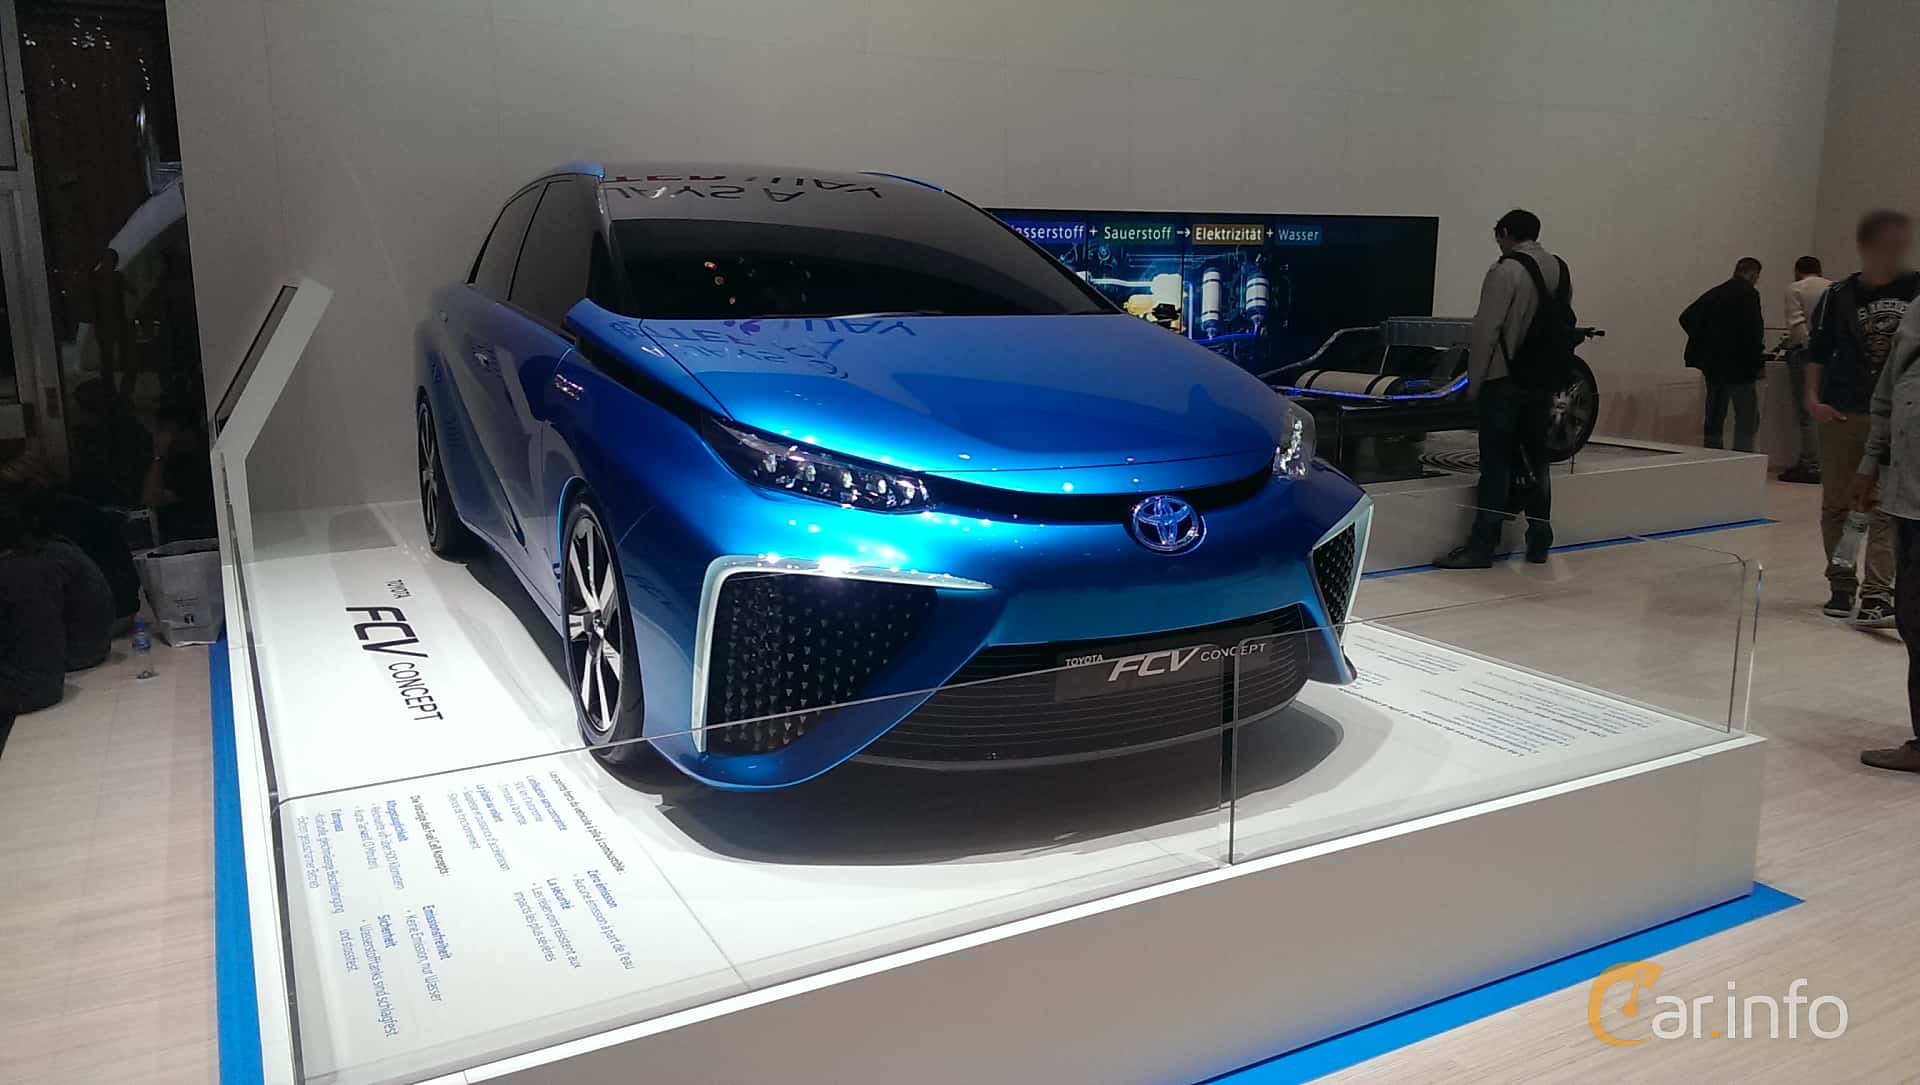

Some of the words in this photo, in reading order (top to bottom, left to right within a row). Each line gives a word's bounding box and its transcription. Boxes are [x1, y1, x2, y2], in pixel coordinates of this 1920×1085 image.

[1012, 225, 1085, 241] asserstoff
[1103, 225, 1172, 240] Sauerstoff
[1195, 227, 1262, 241] Elektrizität
[1277, 228, 1319, 241] Wasser
[345, 606, 429, 658] FCV
[388, 662, 444, 721] CONCEPT
[1065, 653, 1104, 668] TOYOTA
[1107, 645, 1202, 682] FCV
[1200, 642, 1267, 663] CONCEPT
[376, 913, 398, 948] Sicherheit
[404, 913, 422, 933] Keine
[419, 961, 434, 976] nur
[372, 978, 390, 997] sind
[422, 973, 446, 1003] Wasser
[373, 994, 401, 1038] schlagfest
